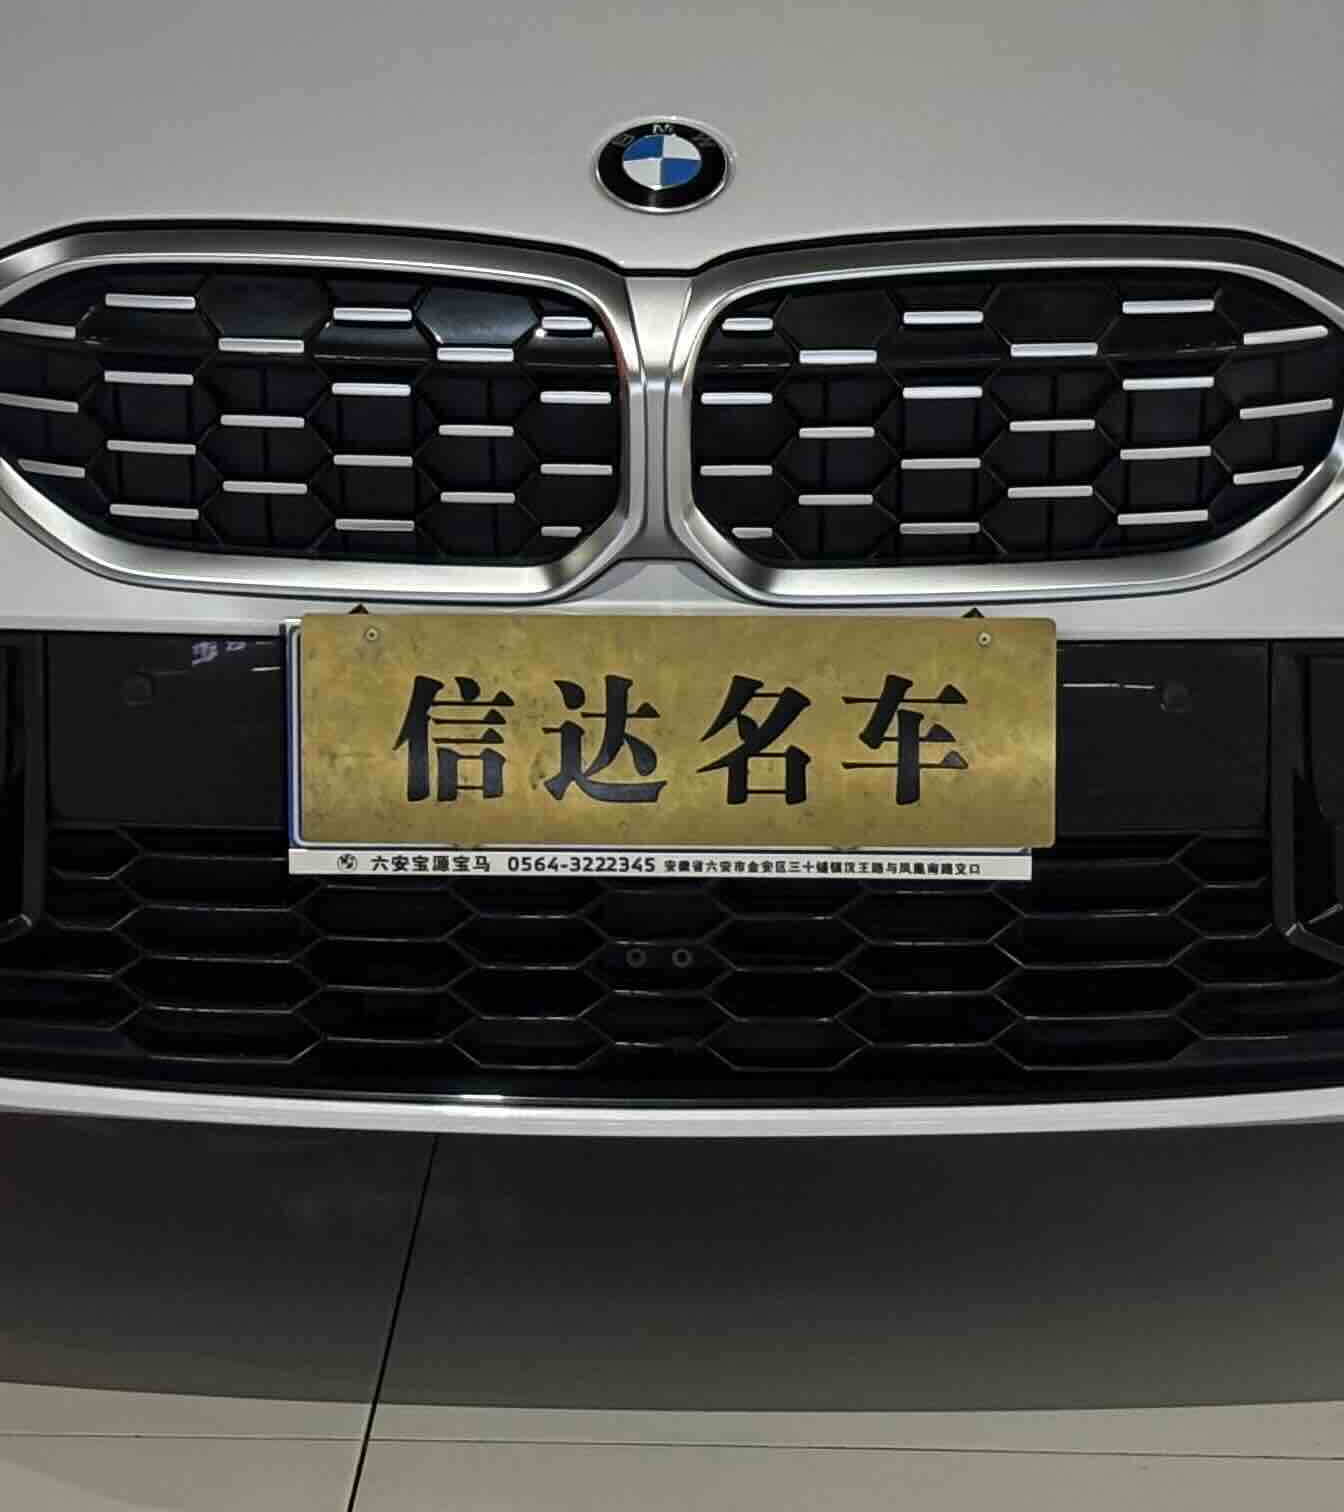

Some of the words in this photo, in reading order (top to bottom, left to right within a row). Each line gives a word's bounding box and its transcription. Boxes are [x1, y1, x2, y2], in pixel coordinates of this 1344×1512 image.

[392, 673, 970, 806] 信达名车
[507, 856, 656, 873] 0564-3222345
